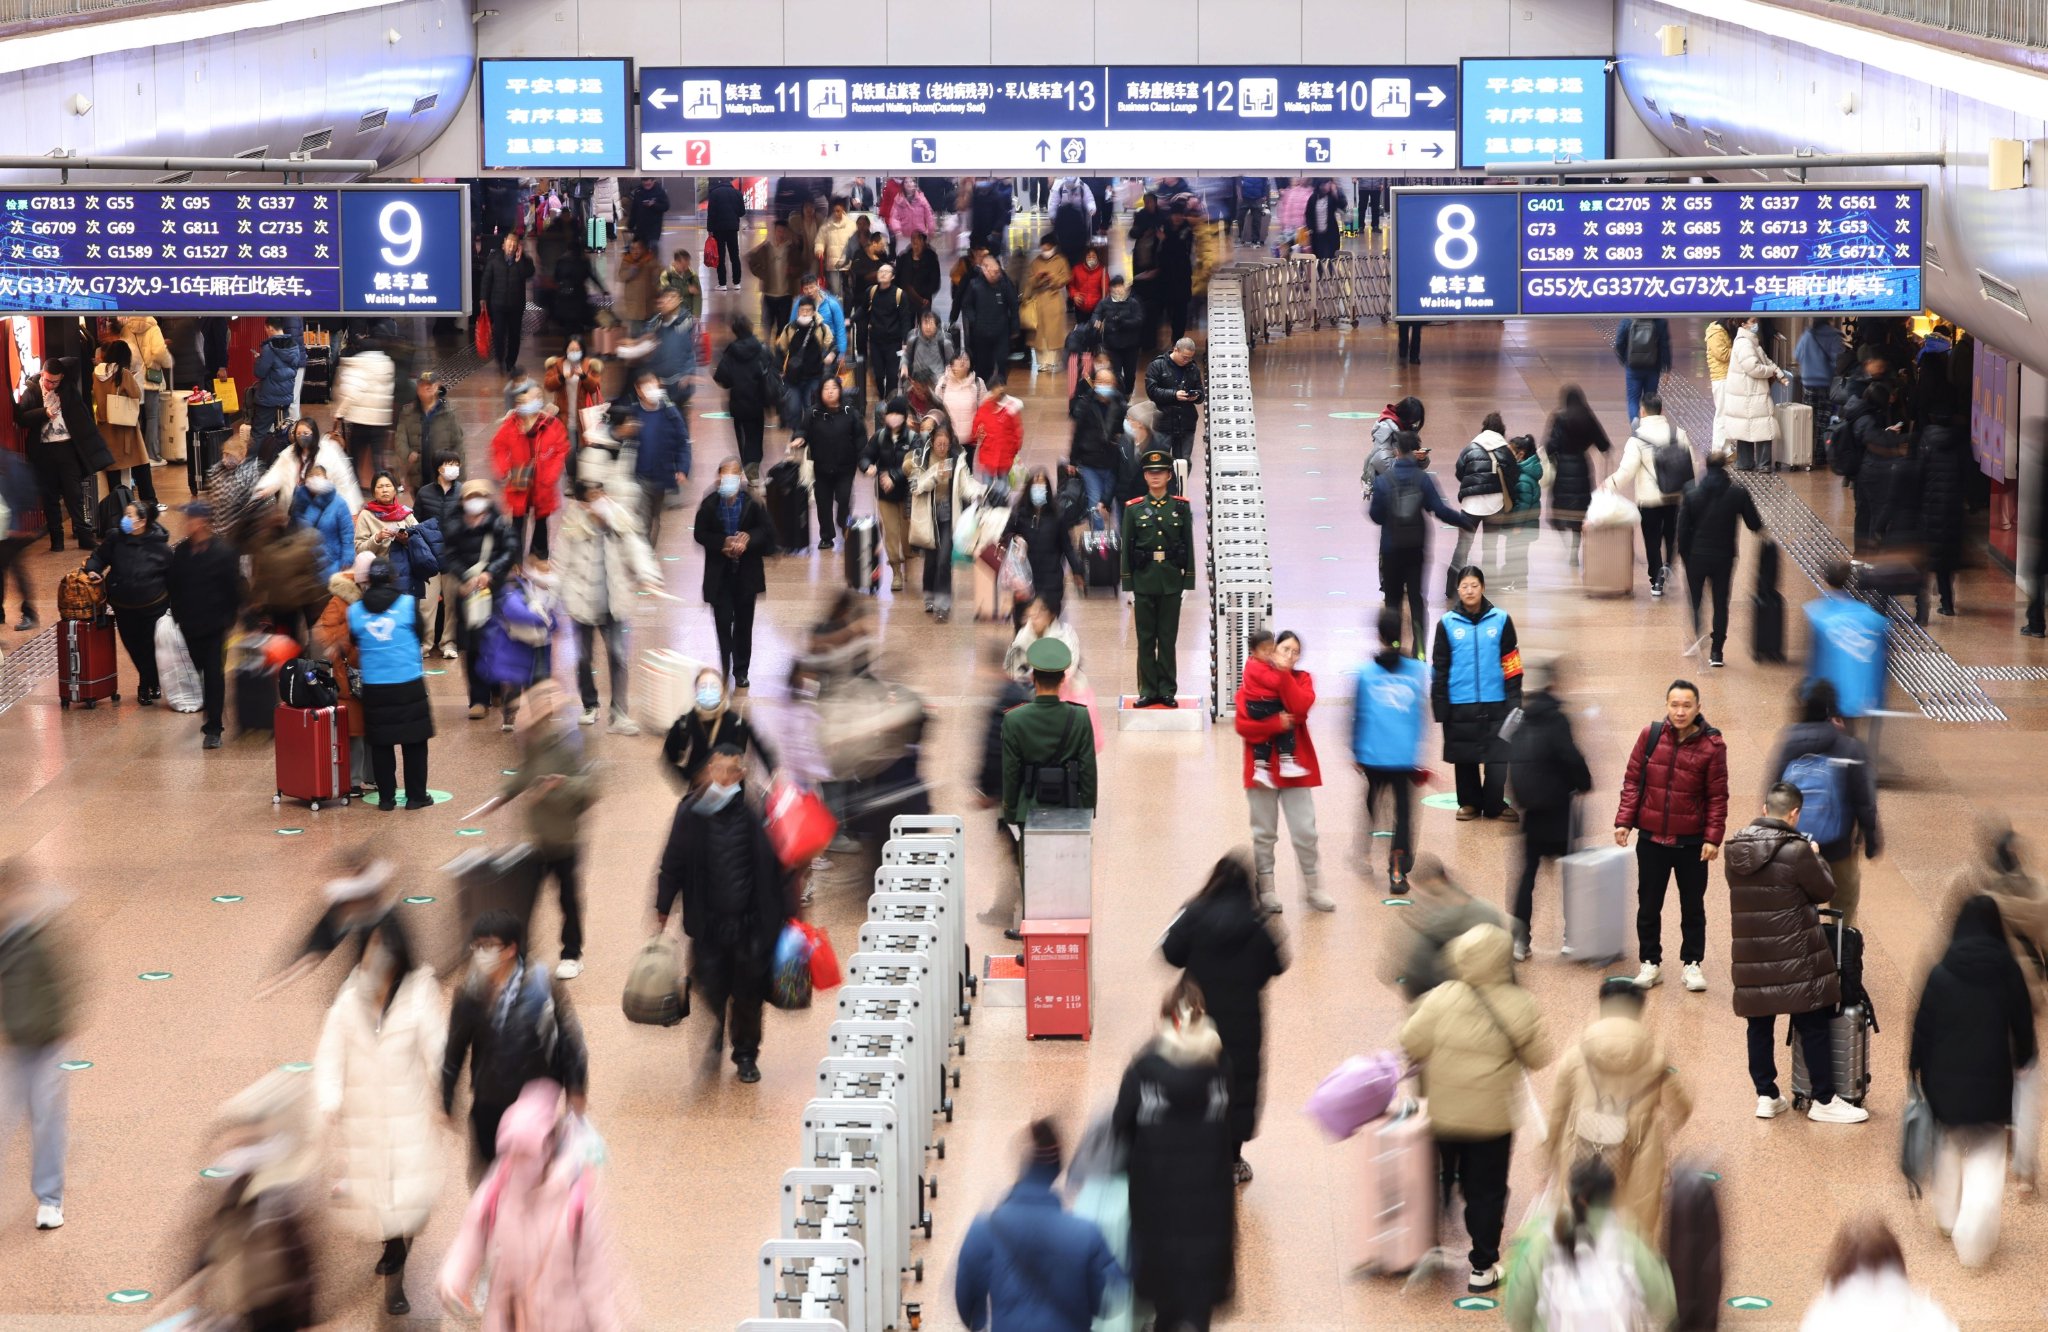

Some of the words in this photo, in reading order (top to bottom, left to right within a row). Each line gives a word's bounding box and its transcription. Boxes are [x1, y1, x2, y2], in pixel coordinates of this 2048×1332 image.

[505, 77, 603, 94] 平安春运
[1485, 77, 1584, 94] 平安春运
[725, 82, 762, 101] 候车室
[775, 81, 800, 112] 11
[1063, 80, 1096, 112] 13
[1126, 81, 1200, 100] 商务座候车室
[1202, 80, 1234, 112] 12
[1297, 81, 1334, 100] 候车室
[1336, 80, 1368, 112] 10
[505, 108, 604, 124] 有序春运
[724, 103, 752, 116] Waiting
[752, 103, 775, 114] Room
[851, 102, 885, 113] Reserved
[885, 102, 911, 114] Waiting
[1117, 102, 1150, 112] Business
[1150, 102, 1170, 112] Class
[1170, 102, 1198, 114] Lounge
[1283, 101, 1311, 114] Waiting
[1311, 101, 1333, 112] Room
[1485, 107, 1584, 124] 有序春运
[31, 197, 75, 210] G7813
[85, 195, 100, 210] 次
[106, 197, 135, 210] G55
[160, 195, 176, 210] 次
[182, 197, 211, 210] G95
[236, 195, 252, 210] 次
[258, 197, 296, 210] G337
[313, 195, 329, 210] 次
[1527, 198, 1565, 212] G401
[1605, 198, 1651, 211] C2705
[1661, 195, 1677, 211] 次
[1683, 197, 1713, 210] G55
[1739, 195, 1755, 210] 次
[1761, 197, 1800, 210] G337
[1817, 195, 1833, 210] 次
[1839, 196, 1877, 210] G561
[1895, 194, 1911, 209] 次
[10, 219, 26, 234] 次
[31, 221, 77, 235] G6709
[85, 219, 101, 234] 次
[106, 221, 136, 235] G69
[161, 219, 177, 234] 次
[182, 221, 220, 235] G811
[237, 219, 253, 234] 次
[258, 221, 303, 235] C2735
[313, 219, 329, 234] 次
[378, 200, 423, 266] 9
[1527, 222, 1557, 237] G73
[1583, 221, 1599, 236] 次
[1605, 222, 1643, 236] G893
[1661, 220, 1677, 235] 次
[1683, 221, 1721, 235] G685
[1739, 219, 1755, 235] 次
[1761, 221, 1808, 234] G6713
[1817, 219, 1833, 234] 次
[1839, 220, 1868, 234] G53
[1895, 218, 1911, 234] 次
[1434, 203, 1478, 270] 8
[11, 244, 26, 259] 次
[32, 246, 61, 259] G53
[86, 244, 102, 259] 次
[107, 246, 153, 259] G1589
[161, 244, 177, 259] 次
[183, 245, 229, 259] G1527
[237, 243, 253, 258] 次
[259, 245, 288, 259] G83
[314, 243, 330, 258] 次
[1527, 247, 1575, 261] G1589
[1583, 245, 1599, 261] 次
[1605, 247, 1643, 261] G803
[1661, 245, 1677, 260] 次
[1683, 246, 1721, 260] G895
[1739, 244, 1755, 260] 次
[1761, 245, 1800, 259] G807
[1817, 244, 1833, 258] 次
[1839, 245, 1886, 259] G6717
[1895, 243, 1911, 258] 次
[373, 272, 429, 290] 候车室
[1429, 275, 1486, 294] 候车室
[364, 293, 406, 306] Waiting
[408, 293, 437, 304] Room
[1420, 297, 1462, 310] Waiting
[1464, 297, 1494, 307] Room
[1031, 944, 1079, 954] 灭火器箱
